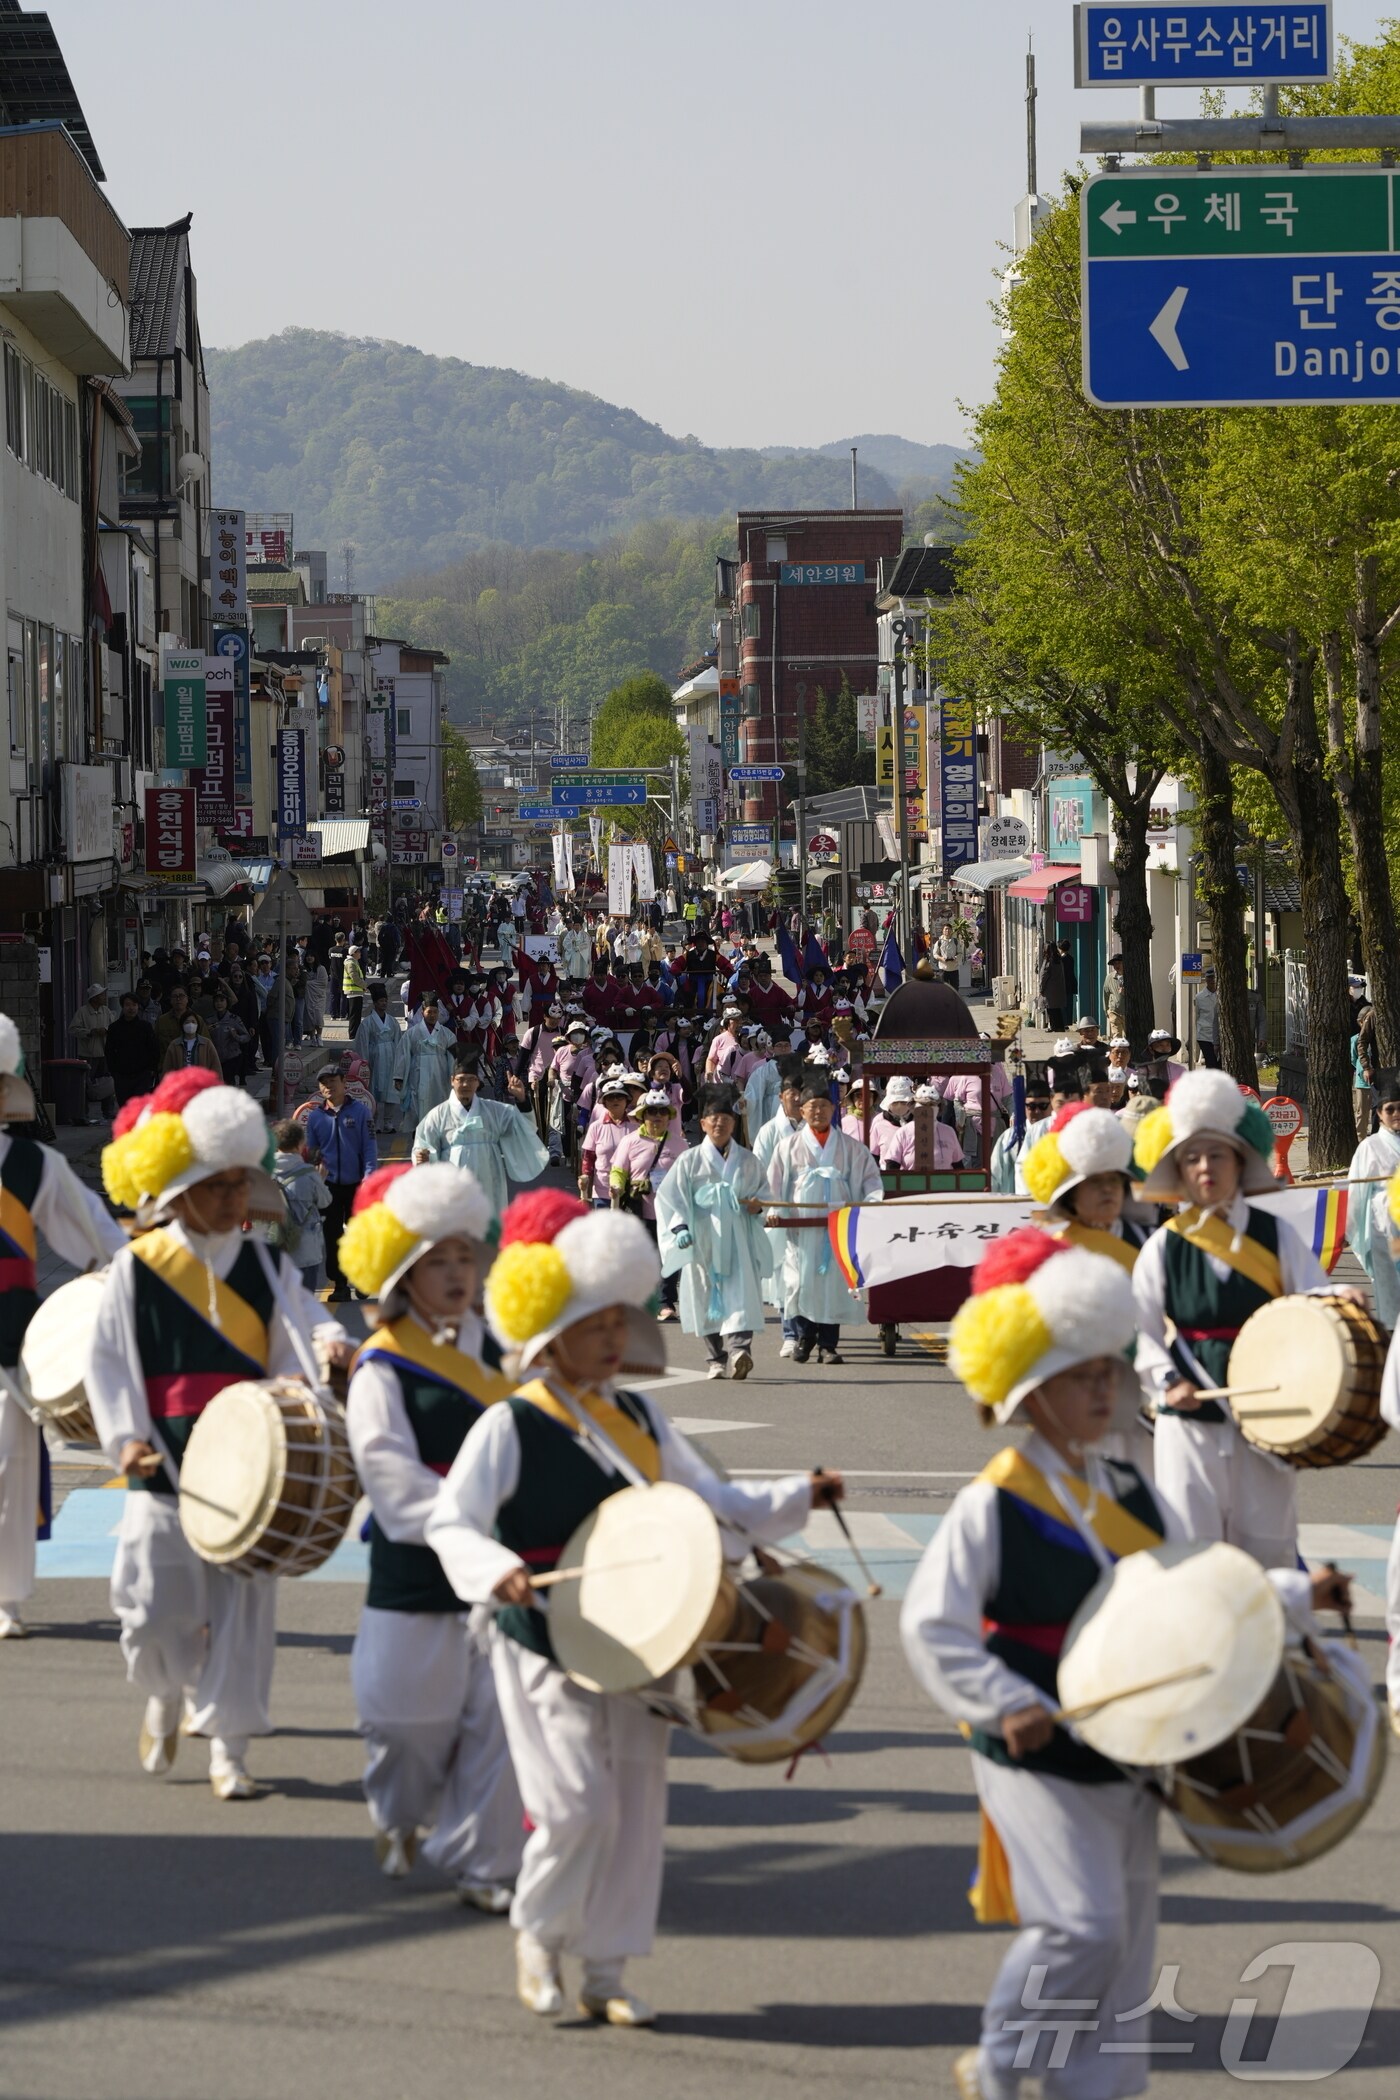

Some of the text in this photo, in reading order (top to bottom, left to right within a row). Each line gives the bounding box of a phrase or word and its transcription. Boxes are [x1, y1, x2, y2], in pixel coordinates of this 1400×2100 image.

[1098, 15, 1318, 71] 읍사무소삼거리
[1147, 192, 1299, 237] 우체국
[1275, 341, 1400, 383] Danjo
[217, 514, 238, 525] 영월
[218, 529, 238, 609] 능이백숙
[788, 566, 857, 584] 세안의원
[212, 612, 245, 621] 375-5310
[169, 659, 200, 669] WILO
[176, 686, 196, 762] 윌로펌프
[552, 756, 588, 766] 터미널사거리
[1048, 763, 1090, 772] 375-3652
[282, 730, 301, 825] 중앙오토바이
[586, 789, 613, 797] 중앙로
[944, 765, 976, 859] 영월의료기
[156, 792, 185, 868] 용진식당
[992, 818, 1023, 832] 영월군
[815, 836, 831, 852] 옷
[990, 833, 1027, 847] 장례문화
[391, 852, 424, 863] 농자재
[1060, 889, 1089, 920] 약
[887, 1222, 1000, 1244] 사육신
